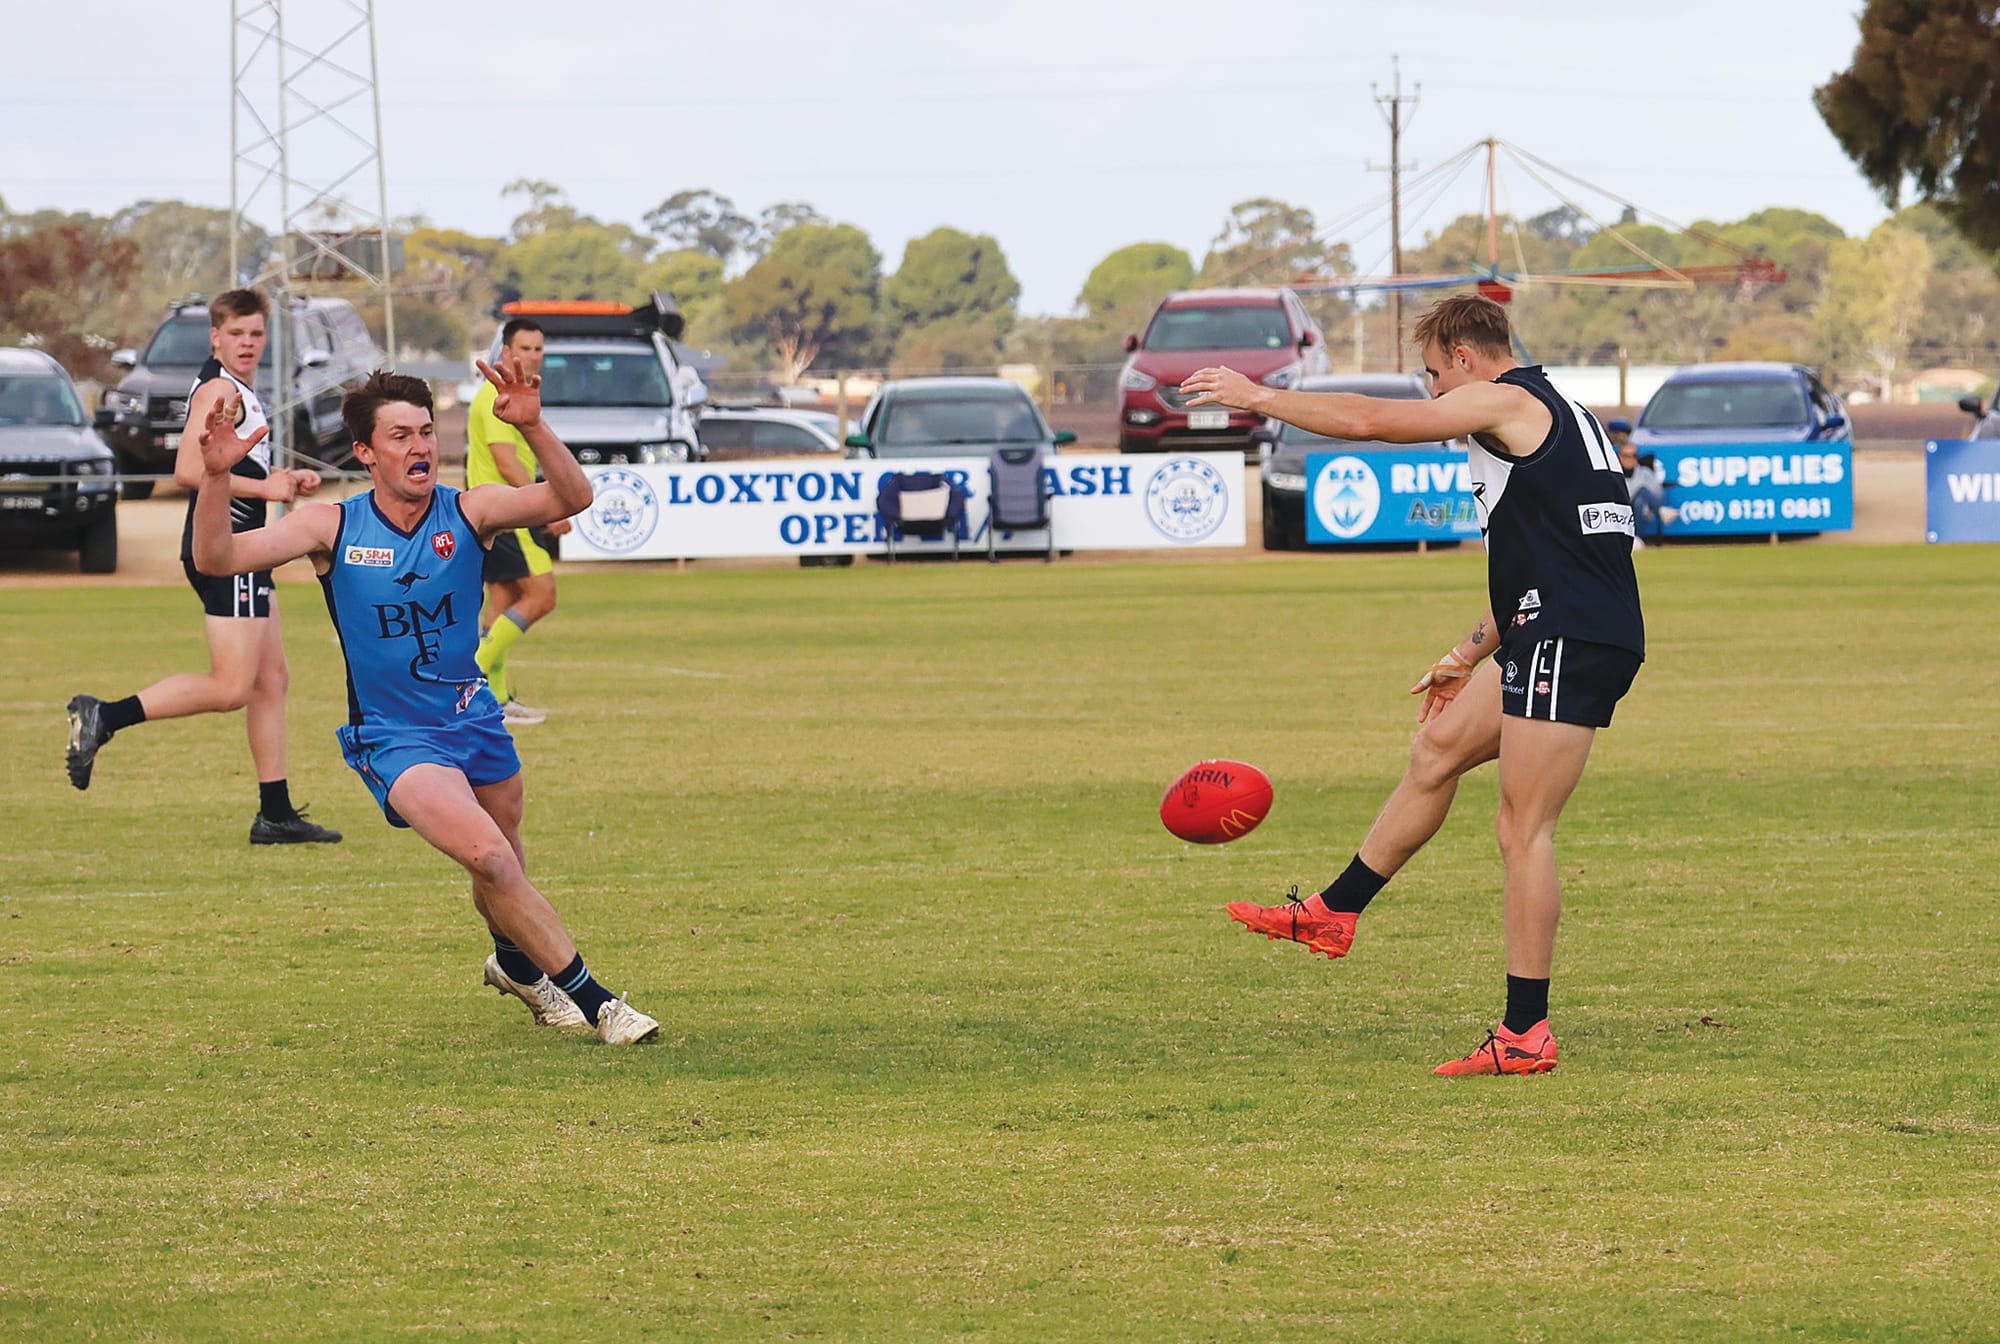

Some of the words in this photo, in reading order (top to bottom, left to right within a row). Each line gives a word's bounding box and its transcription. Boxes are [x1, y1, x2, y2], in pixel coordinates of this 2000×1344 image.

[1678, 453, 1844, 487] SUPPLIES
[668, 472, 862, 504] LOXTON
[1680, 499, 1725, 525] (08)
[1728, 499, 1775, 520] 8121
[434, 534, 454, 548] RFL
